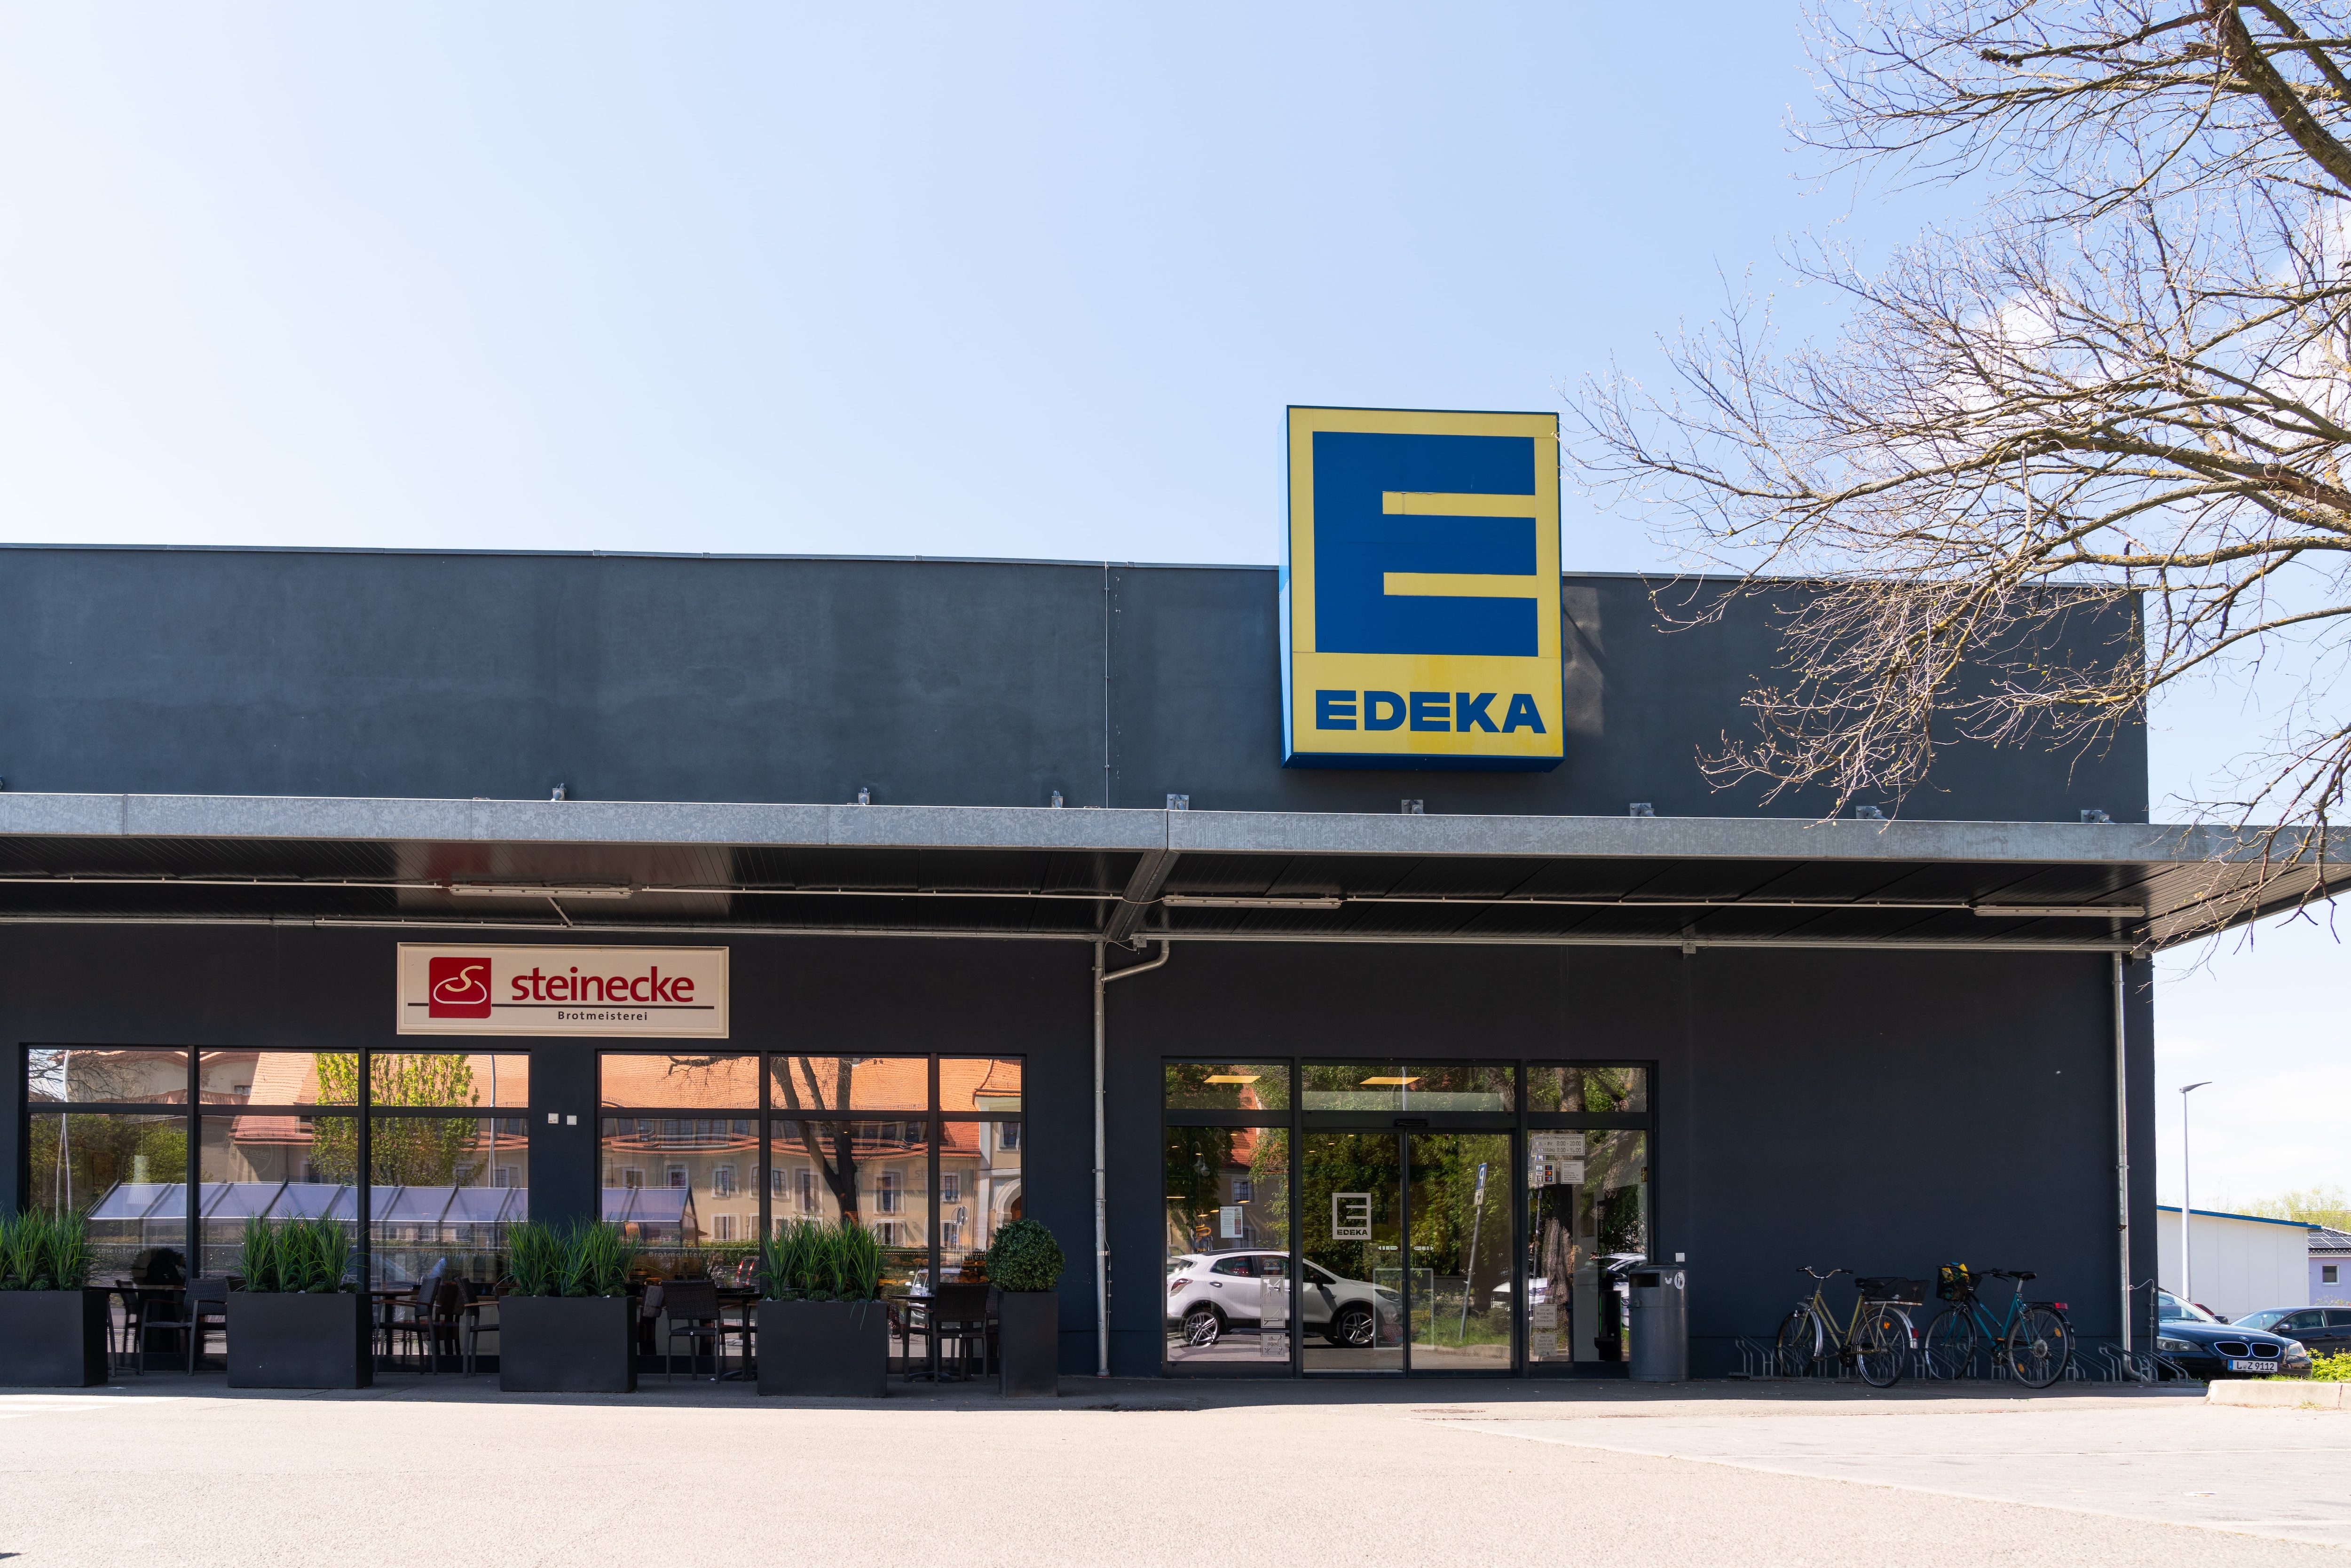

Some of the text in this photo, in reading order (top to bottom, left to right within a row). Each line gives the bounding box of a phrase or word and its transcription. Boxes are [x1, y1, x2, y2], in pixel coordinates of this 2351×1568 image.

[1312, 431, 1538, 657] E
[1316, 690, 1546, 733] EDEKA
[512, 966, 694, 1002] steinecke
[558, 1011, 648, 1021] Brotmeisterei
